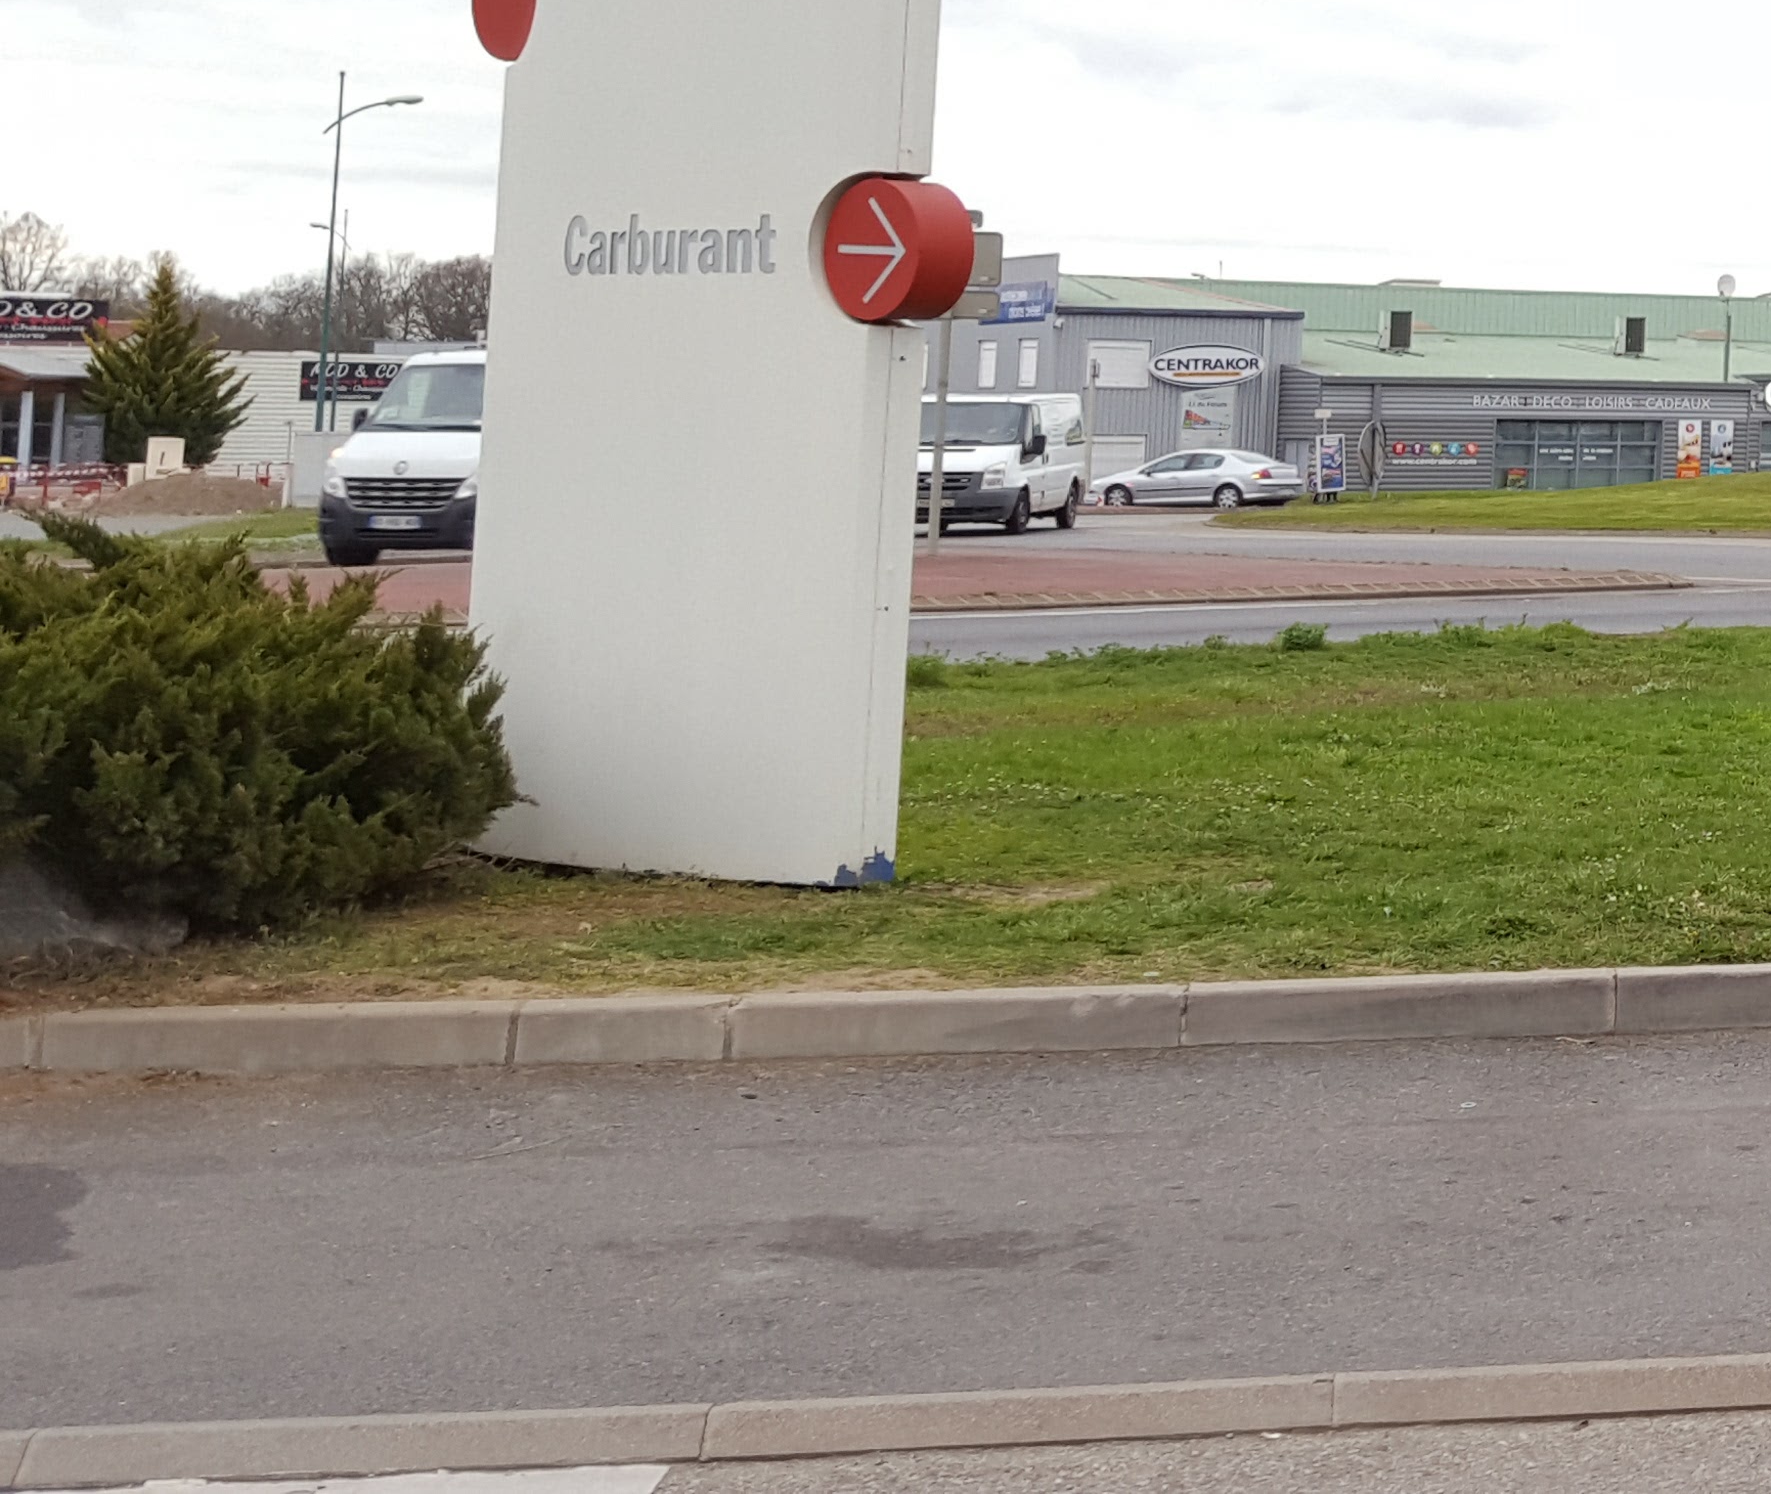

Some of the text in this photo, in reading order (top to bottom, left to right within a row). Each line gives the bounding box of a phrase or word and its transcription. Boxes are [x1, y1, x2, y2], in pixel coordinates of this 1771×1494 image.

[564, 213, 777, 276] Carburant
[46, 301, 93, 320] CO
[375, 364, 399, 378] CO
[1154, 358, 1260, 371] CENTRAKOR
[1472, 395, 1520, 407] BAZAR
[1585, 396, 1633, 408] LOISIRS
[1645, 397, 1711, 410] CADEAUX
